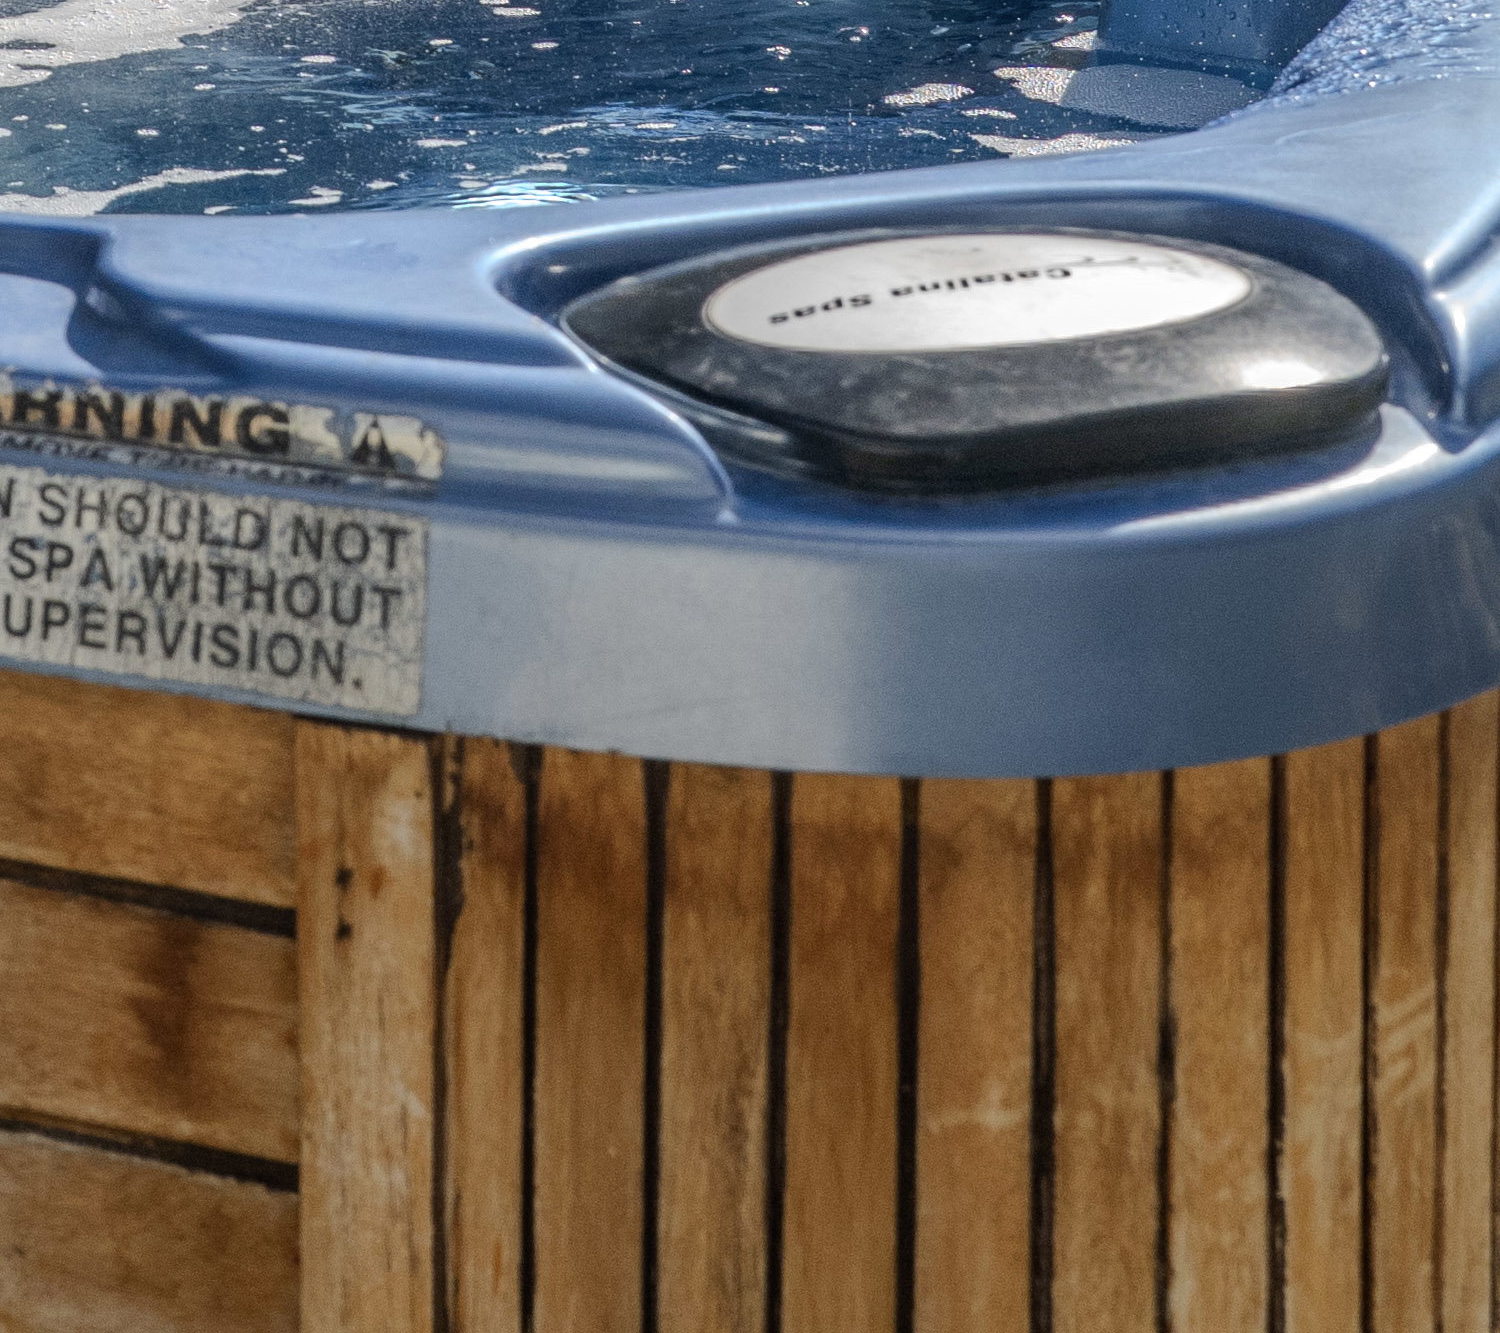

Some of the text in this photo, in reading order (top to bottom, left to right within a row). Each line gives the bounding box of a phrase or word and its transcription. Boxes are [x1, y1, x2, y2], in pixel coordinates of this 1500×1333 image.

[768, 266, 1072, 324] Catalina Spas
[38, 483, 271, 552] SHOULD
[290, 513, 408, 571] NOT
[8, 535, 114, 592] SPA
[139, 552, 403, 630] WITHOUT
